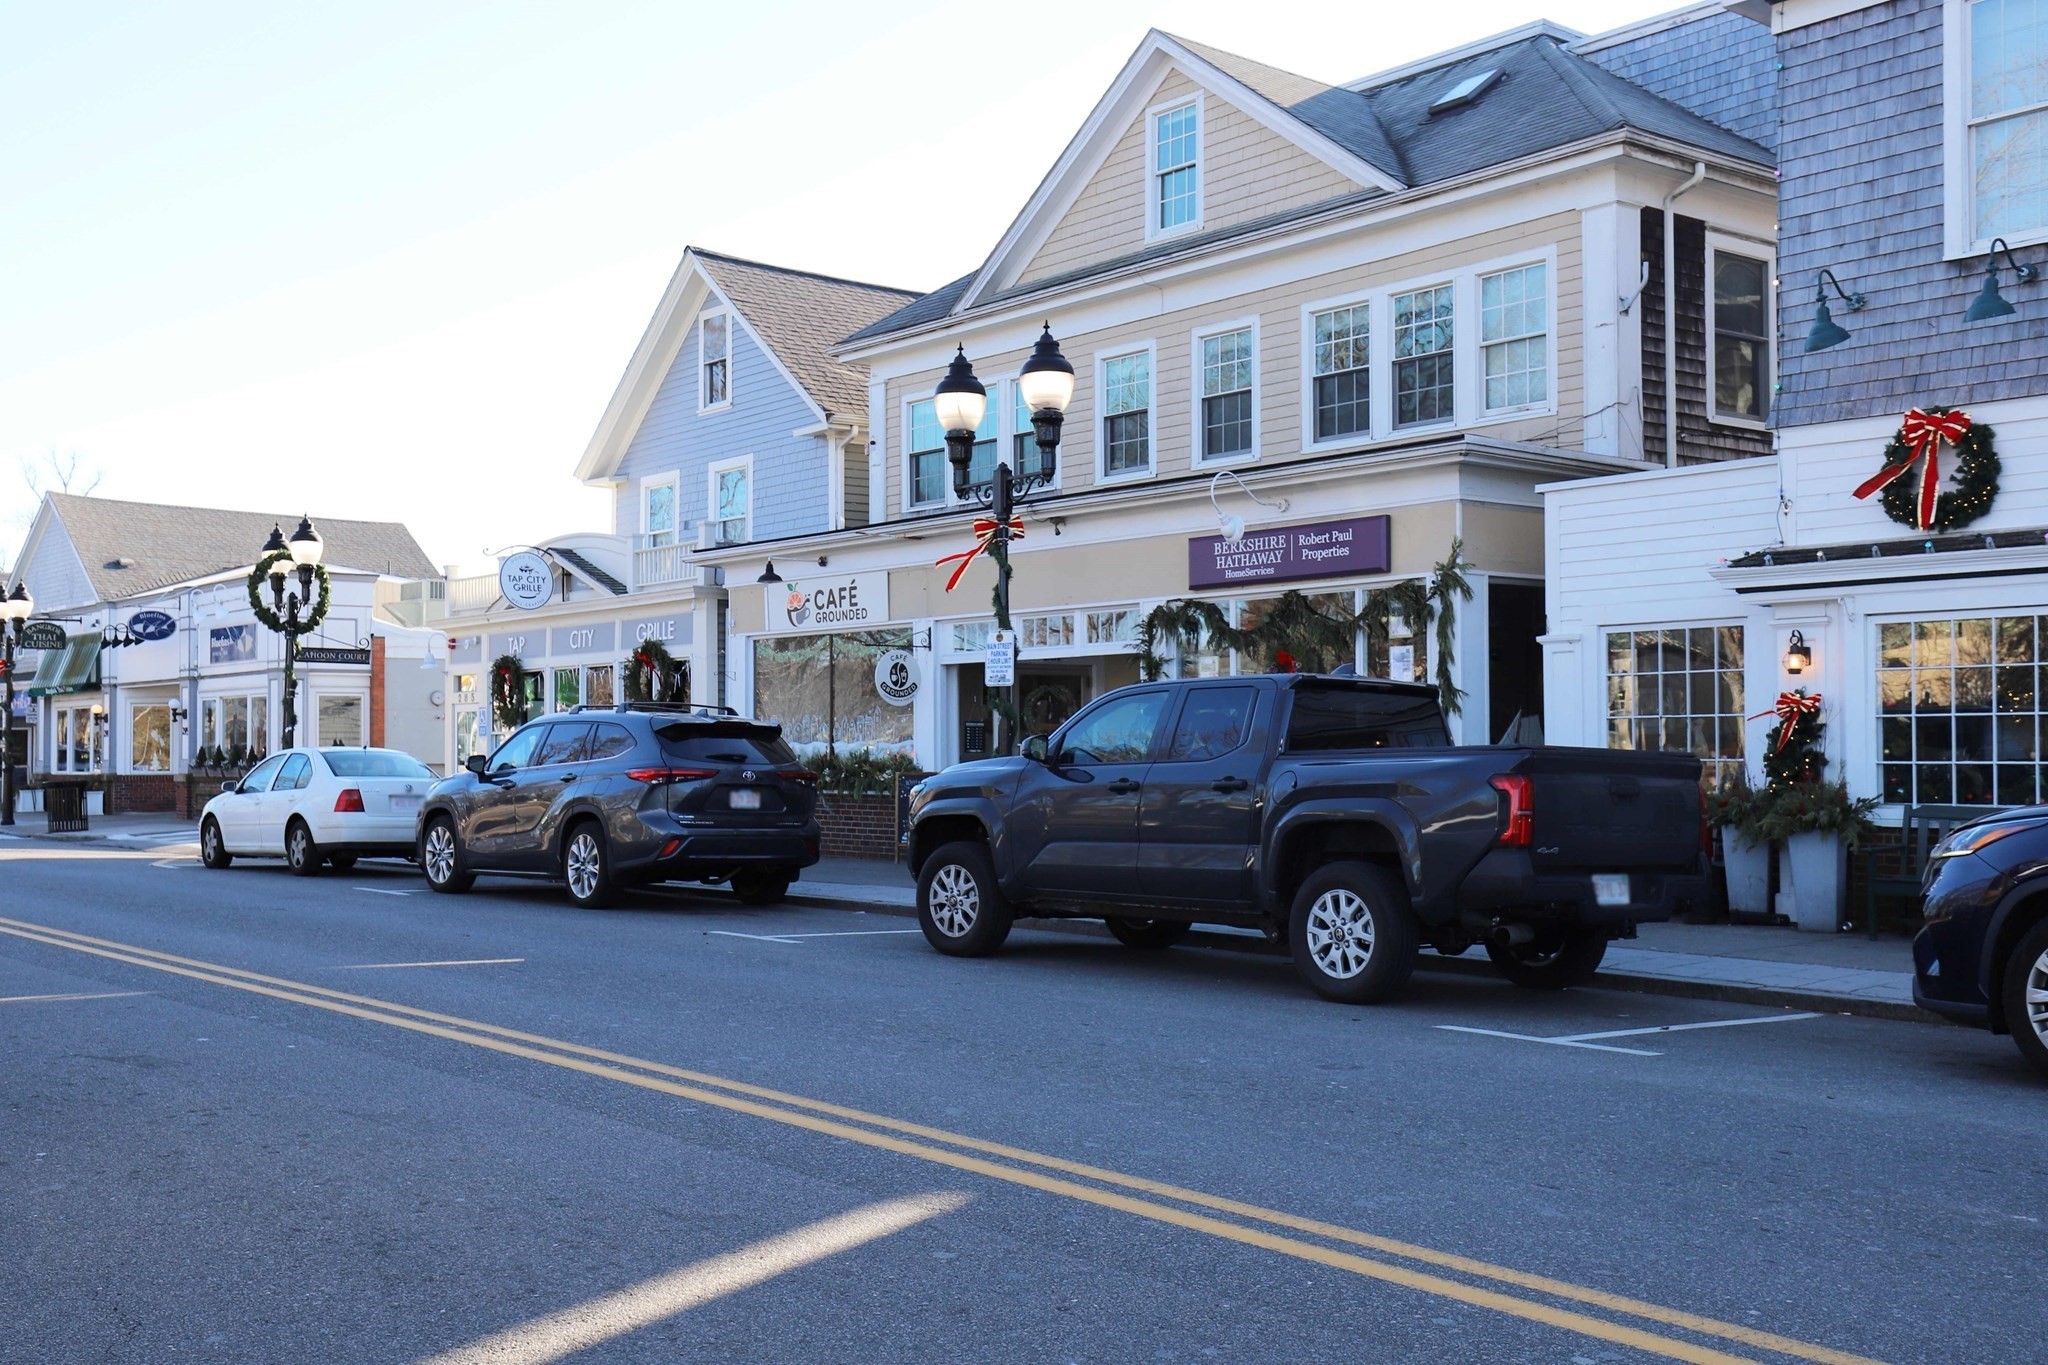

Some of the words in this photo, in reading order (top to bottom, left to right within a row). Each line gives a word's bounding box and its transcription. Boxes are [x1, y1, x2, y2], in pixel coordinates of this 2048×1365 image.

[1298, 532, 1330, 546] Robert
[1332, 528, 1353, 542] Paul
[1214, 535, 1286, 555] BERKSHIRE
[1216, 550, 1284, 569] HATHAWAY
[1301, 545, 1350, 561] Properties
[1225, 566, 1275, 579] HomeServices
[526, 576, 546, 584] CITY
[513, 583, 542, 592] GRILLE
[814, 579, 858, 610] CAFÉ
[139, 611, 167, 621] Bluefins
[815, 608, 868, 623] GROUNDED
[32, 632, 57, 641] THAI
[508, 637, 525, 654] TAP
[569, 629, 594, 649] CITY
[636, 620, 676, 643] GRILLE
[24, 640, 63, 649] CUISINE
[338, 652, 368, 661] COURT
[881, 683, 917, 697] GROUNDED
